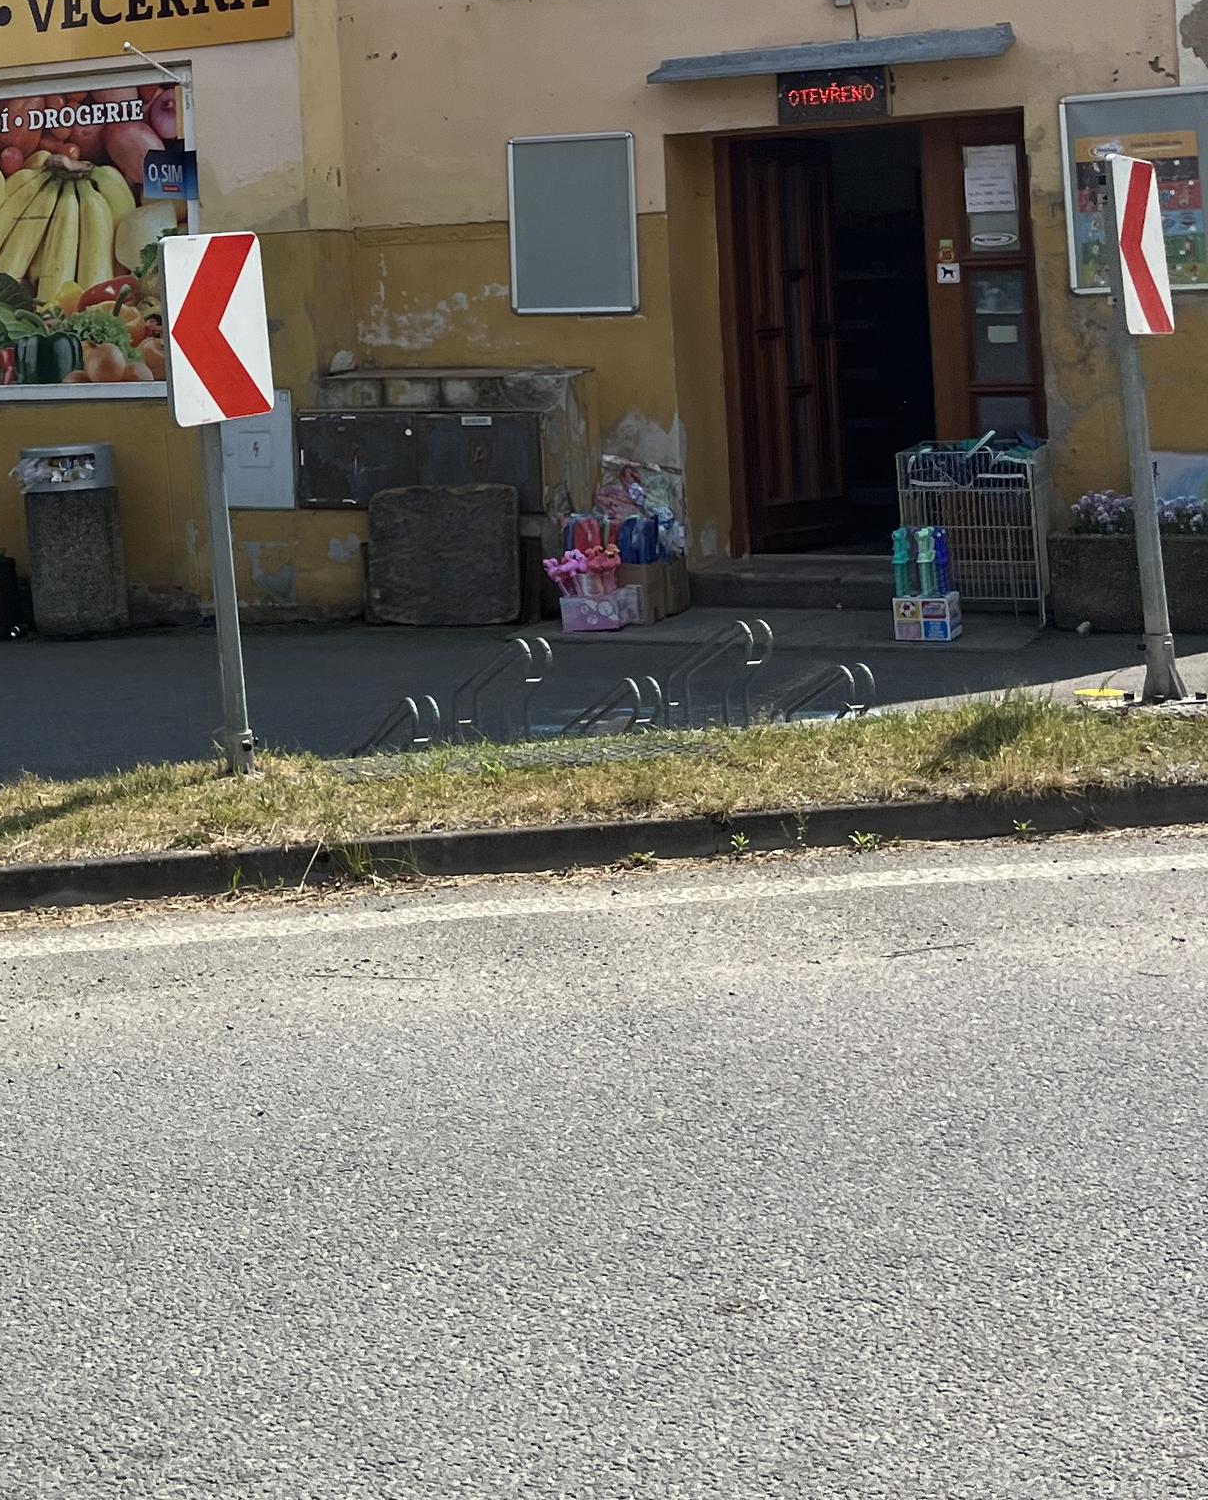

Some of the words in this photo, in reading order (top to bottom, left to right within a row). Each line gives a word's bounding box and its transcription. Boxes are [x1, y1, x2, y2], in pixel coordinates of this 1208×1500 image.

[788, 82, 875, 107] OTEVŘENO
[28, 100, 144, 131] DROGERIE
[161, 164, 183, 183] SIM
